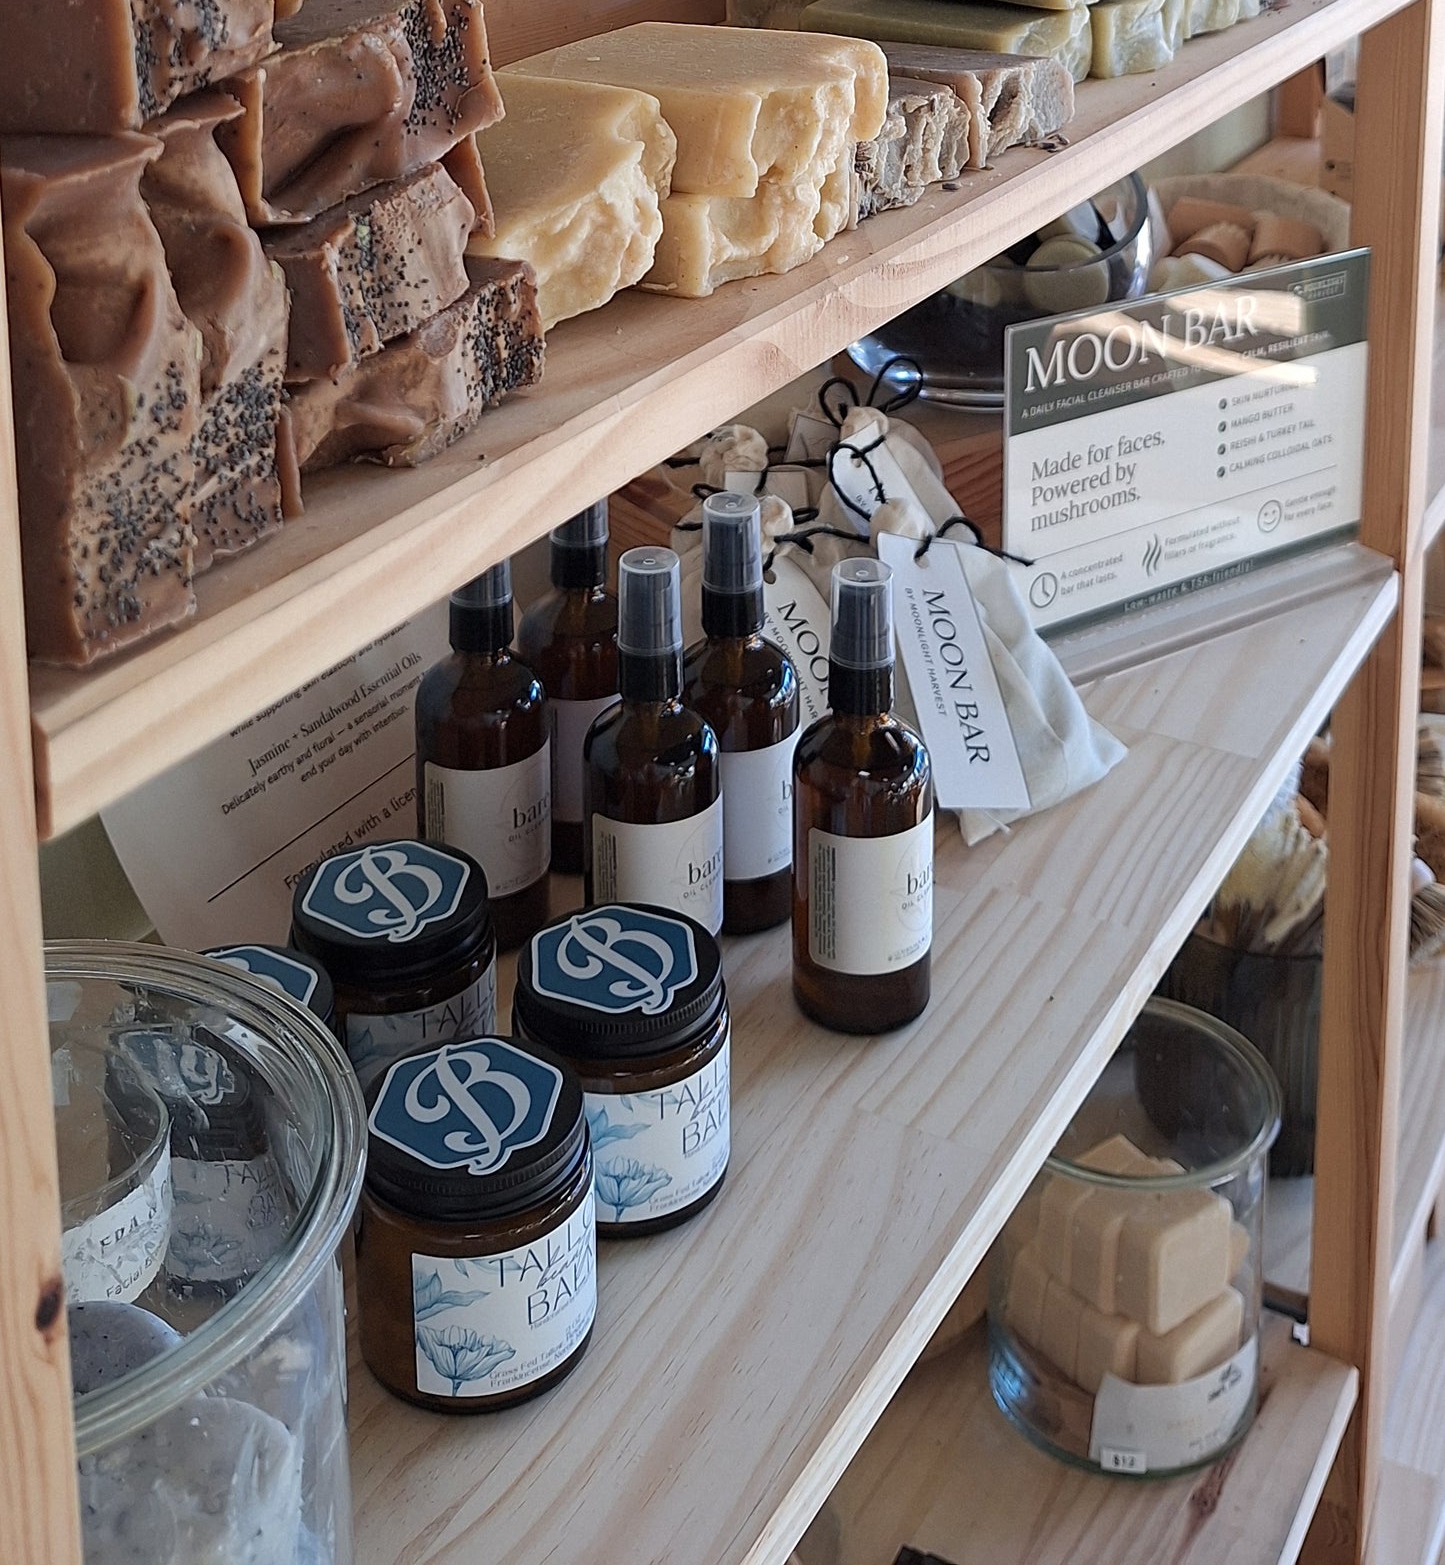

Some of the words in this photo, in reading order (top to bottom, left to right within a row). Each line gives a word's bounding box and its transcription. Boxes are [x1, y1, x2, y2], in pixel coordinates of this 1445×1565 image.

[1024, 315, 1172, 394] MOON
[1183, 296, 1258, 351] BAR
[1021, 408, 1029, 418] A
[1029, 400, 1054, 417] DAILY
[1056, 394, 1086, 409] FACIAL
[1087, 381, 1131, 400] CLEANSER
[1133, 378, 1150, 390] BAR
[1151, 368, 1188, 383] CRAFTED
[1242, 345, 1267, 359] CALM,
[1268, 334, 1308, 353] RESILIENT
[1231, 412, 1260, 428] MANGO
[1262, 402, 1294, 420] BUTTER
[1232, 396, 1250, 407] SKIN
[1031, 452, 1082, 482] Made
[1087, 444, 1114, 466] for
[1118, 431, 1166, 456] faces.
[1229, 453, 1265, 472] CALMING
[1267, 441, 1310, 461] COLLOIDAL
[1230, 436, 1257, 451] REISHI
[1266, 424, 1296, 440] TURKEY
[1299, 419, 1316, 430] TAIL
[1032, 465, 1112, 506] Powered
[1116, 462, 1137, 485] by
[1031, 487, 1141, 532] mushrooms.
[1165, 525, 1210, 546] Formulated
[1211, 516, 1241, 532] without
[1061, 571, 1067, 581] A
[1068, 554, 1123, 578] concentrated
[1061, 585, 1075, 596] bar
[1077, 579, 1094, 591] that
[1095, 571, 1118, 583] lasts.
[905, 587, 915, 601] BY
[910, 603, 934, 667] MOONLIGHT
[926, 667, 948, 717] HARVEST
[922, 589, 973, 692] MOON
[953, 700, 991, 764] BAR
[248, 738, 291, 777] Jasmine
[292, 732, 299, 741] +
[301, 689, 361, 739] Sandalwood
[360, 663, 402, 699] Essential
[402, 652, 422, 670] Oils
[256, 688, 302, 722] supporting
[805, 696, 818, 720] HAR
[221, 777, 267, 815] Delicately
[267, 759, 295, 785] earthy
[296, 748, 312, 766] and
[312, 732, 336, 755] floral
[347, 722, 354, 730] a
[354, 697, 390, 726] sensorial
[390, 677, 422, 702] moment
[301, 766, 318, 783] end
[319, 753, 337, 774] your
[338, 741, 355, 759] day
[354, 729, 373, 746] with
[373, 704, 410, 733] intention.
[354, 815, 381, 842] with
[382, 807, 392, 820] a
[391, 786, 418, 812] licen
[907, 862, 933, 896] bar
[682, 1100, 727, 1155] BAL
[489, 1365, 518, 1380] Grass
[520, 1357, 538, 1370] Fed
